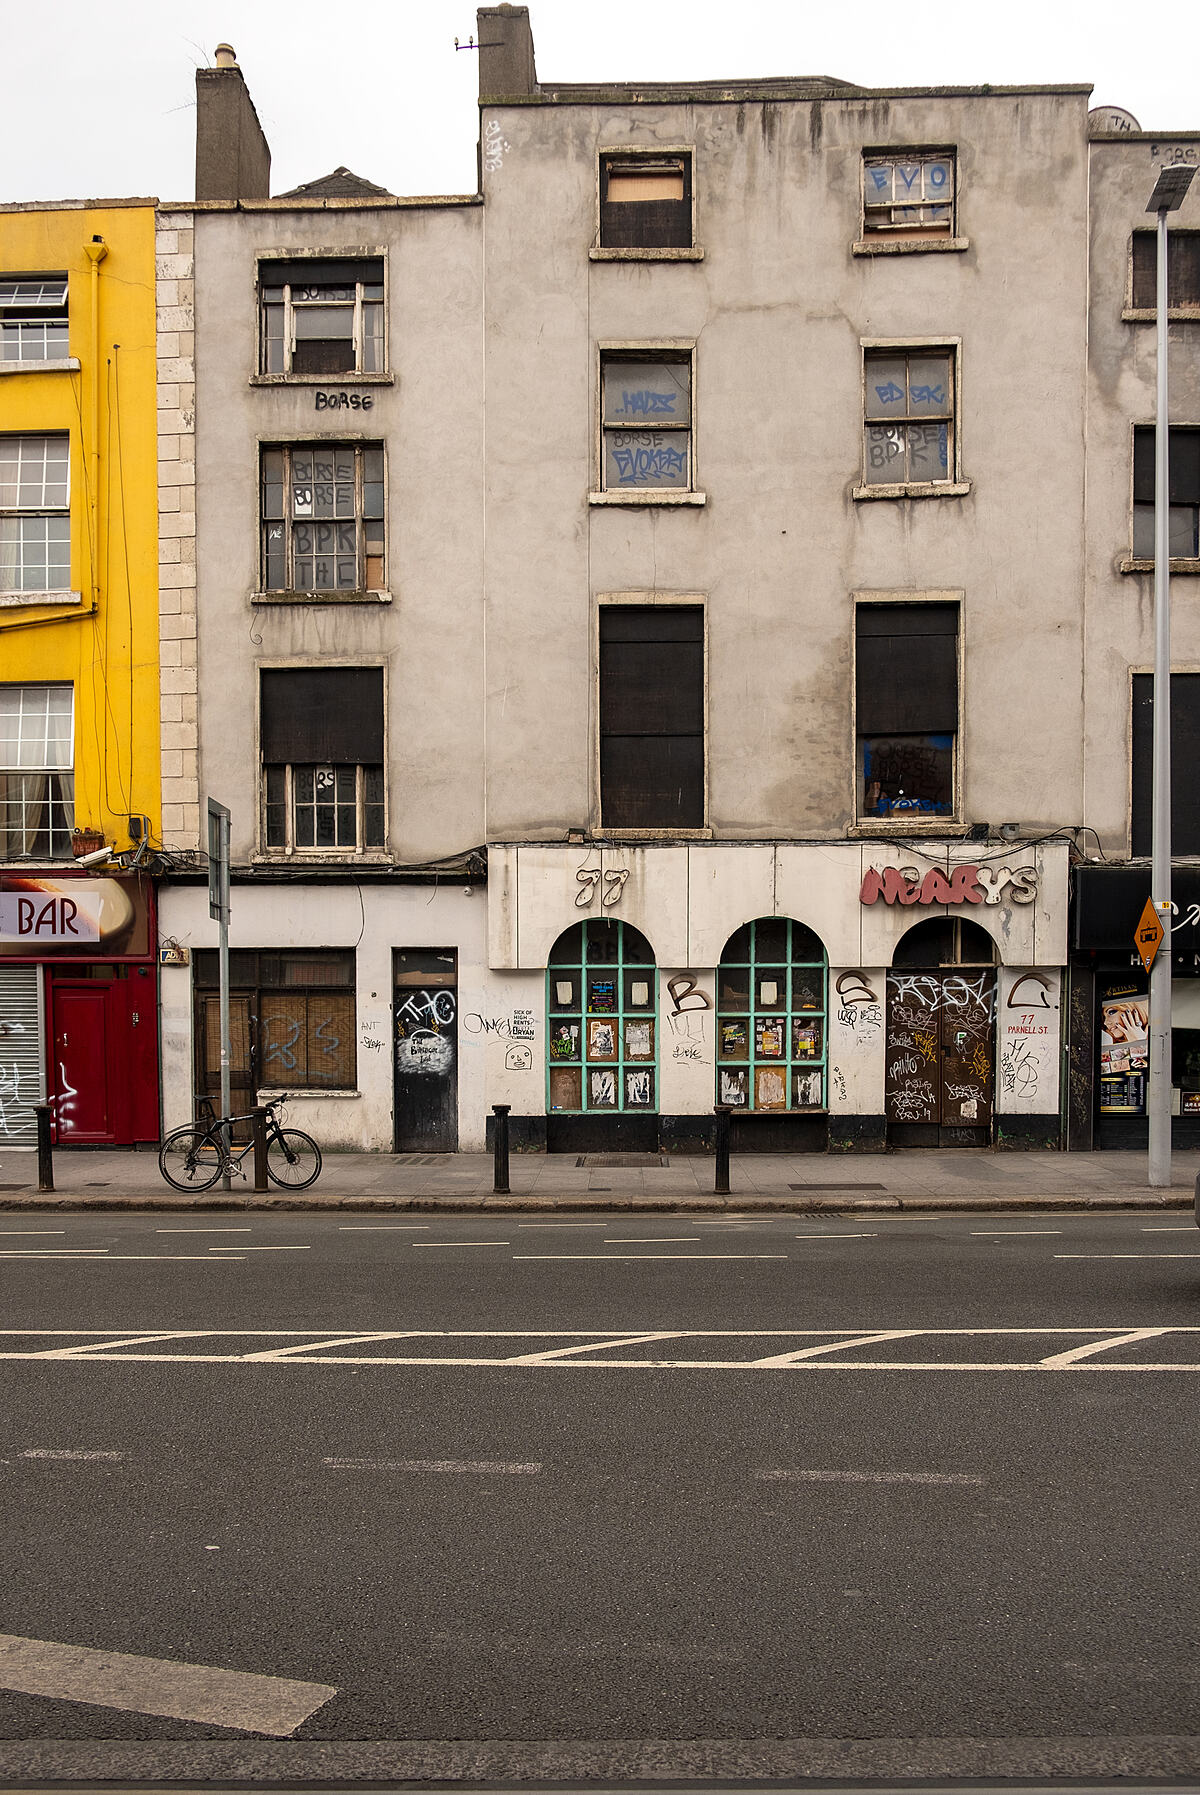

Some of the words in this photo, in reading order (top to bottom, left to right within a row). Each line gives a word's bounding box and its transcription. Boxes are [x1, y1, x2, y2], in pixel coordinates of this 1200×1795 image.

[870, 165, 947, 192] EVO
[316, 391, 374, 412] BORSE
[613, 432, 665, 448] BORSE
[293, 460, 353, 482] BORSE
[292, 486, 352, 507] BORSE
[296, 523, 356, 553] BPK
[17, 897, 79, 935] BAR
[1007, 1025, 1037, 1034] PARNELL
[1020, 1014, 1035, 1025] 77
